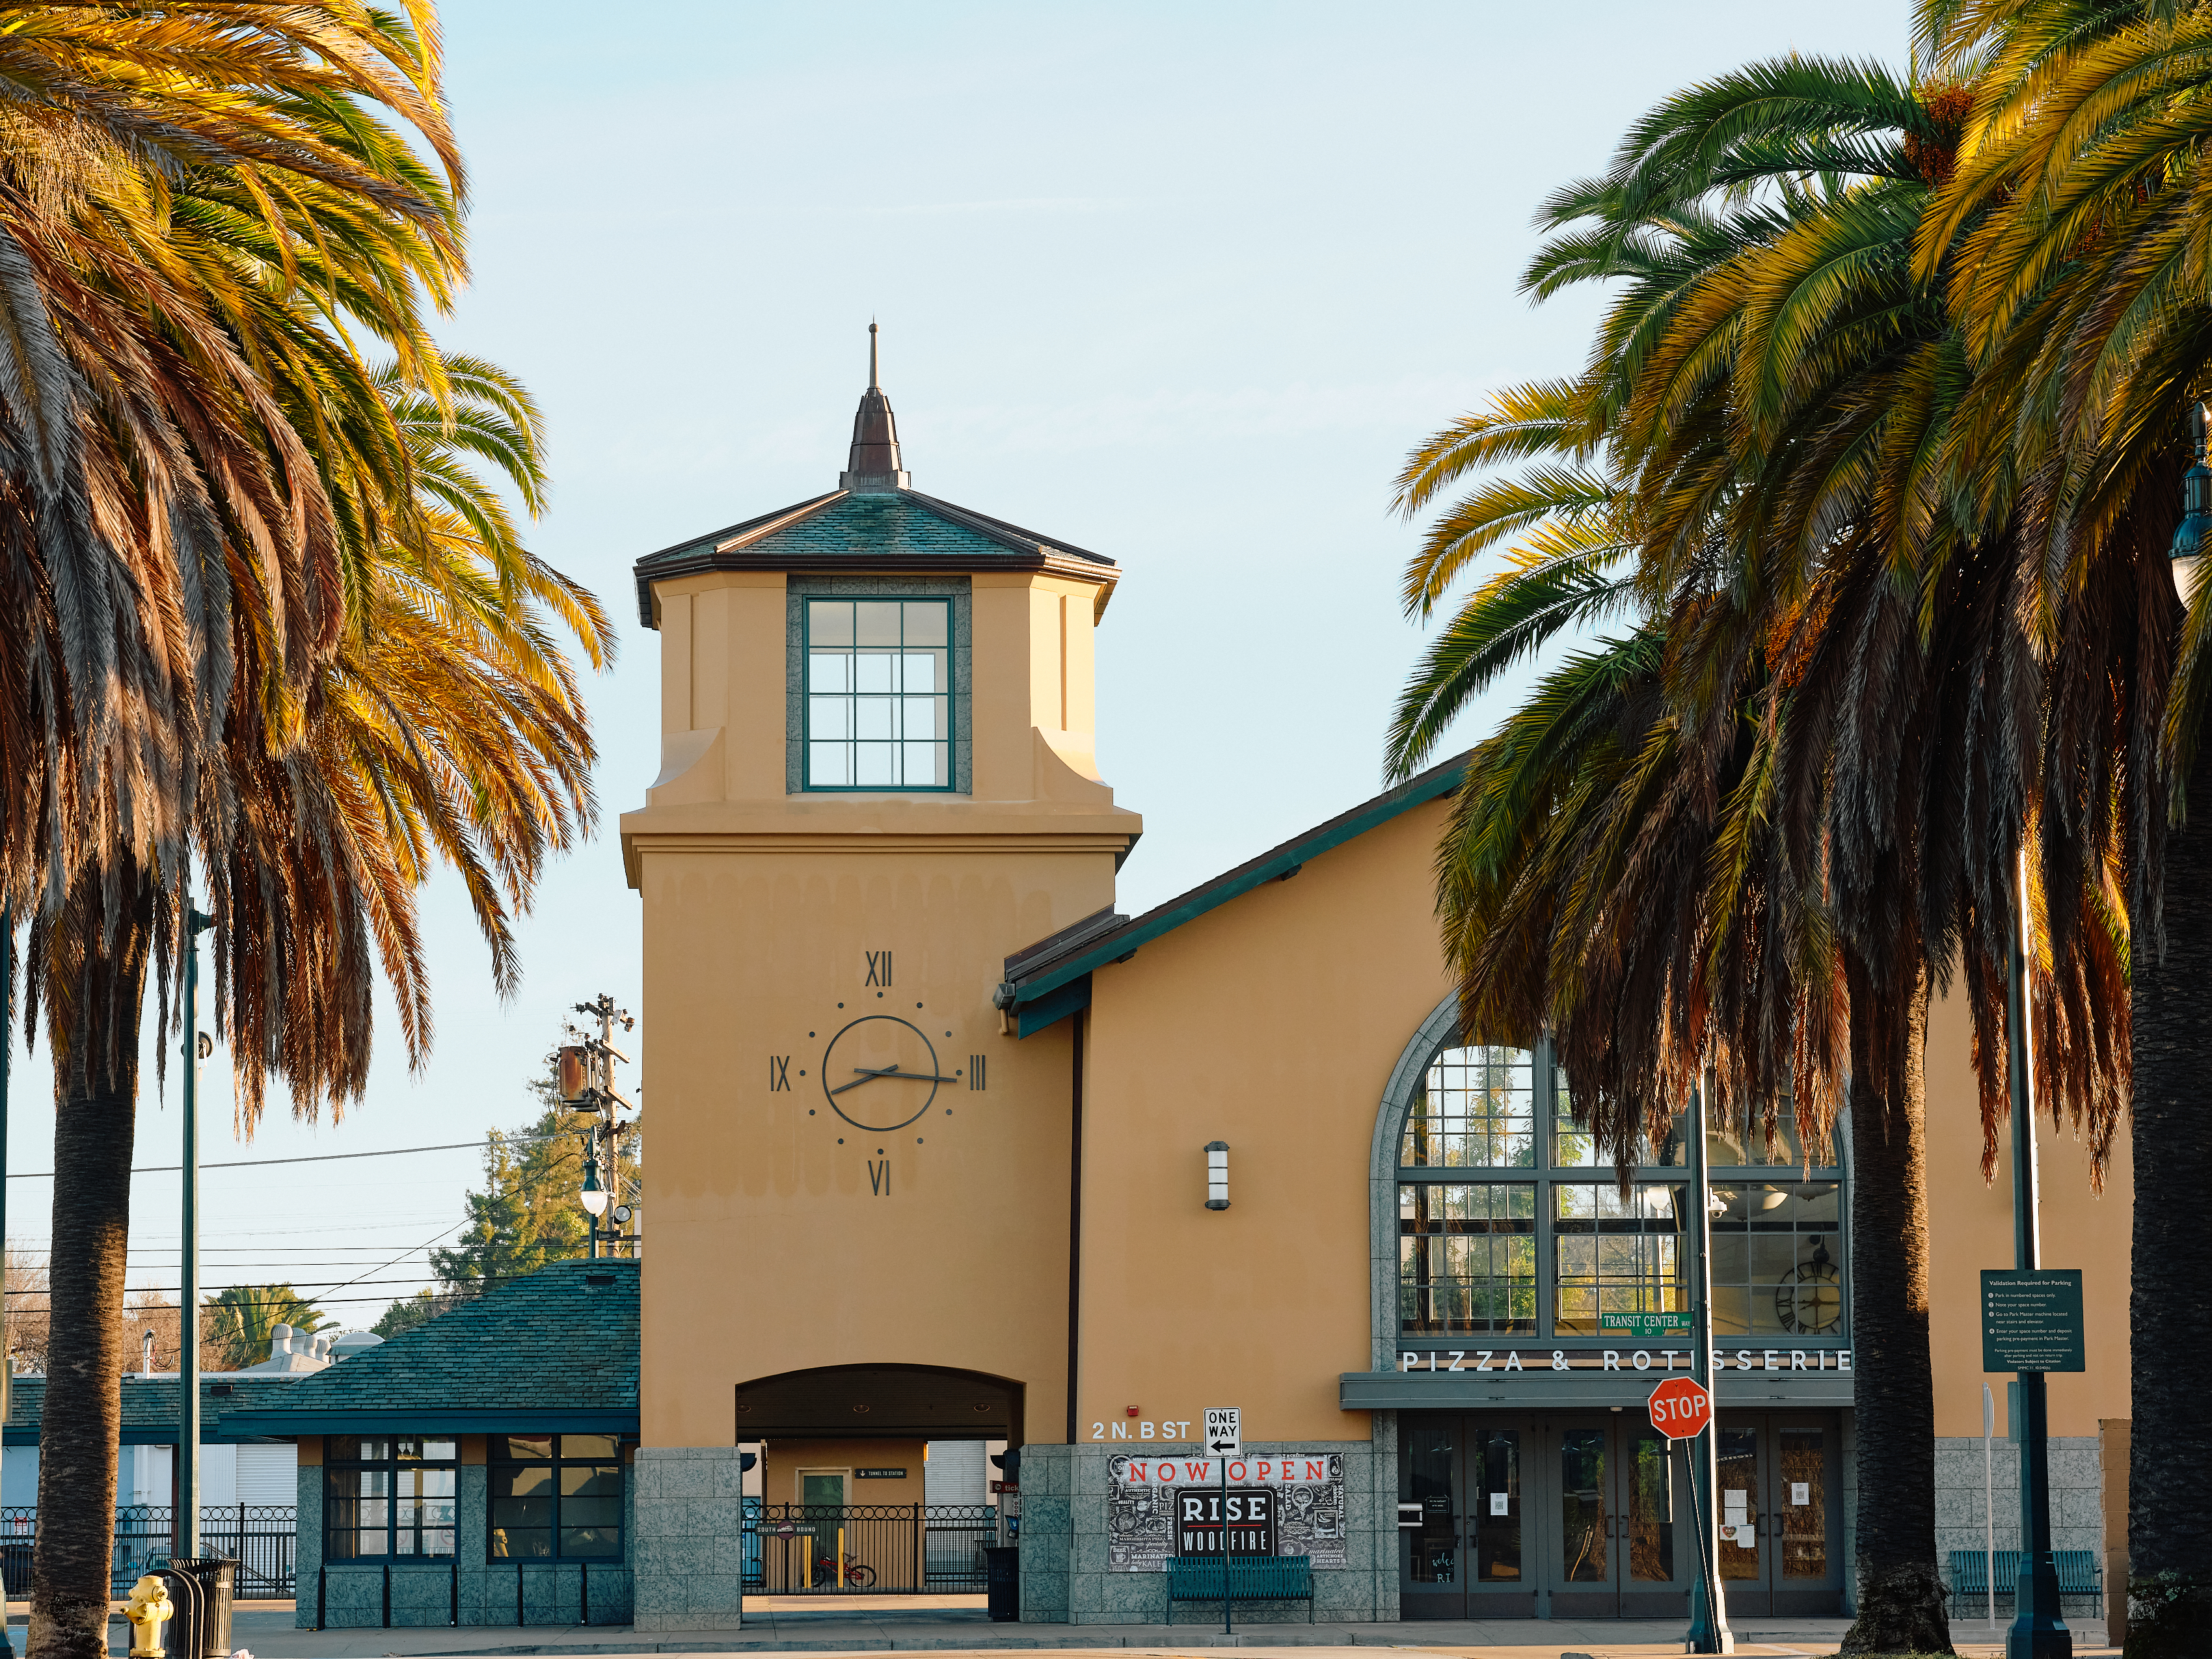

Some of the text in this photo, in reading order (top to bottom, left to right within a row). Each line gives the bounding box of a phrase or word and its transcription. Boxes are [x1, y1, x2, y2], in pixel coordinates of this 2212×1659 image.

[1604, 1315, 1641, 1327] TRANSIT
[1644, 1315, 1679, 1327] CENTER
[1403, 1350, 1851, 1372] PIZZA & ROTISSERIE
[1209, 1412, 1236, 1423] ONE
[1654, 1394, 1706, 1422] STOP
[1092, 1422, 1190, 1439] 2 N. B ST
[1209, 1426, 1237, 1437] WAY
[1129, 1461, 1323, 1481] NOW OPEN
[1183, 1497, 1266, 1521] RISE
[1183, 1531, 1267, 1551] WOODFIRE
